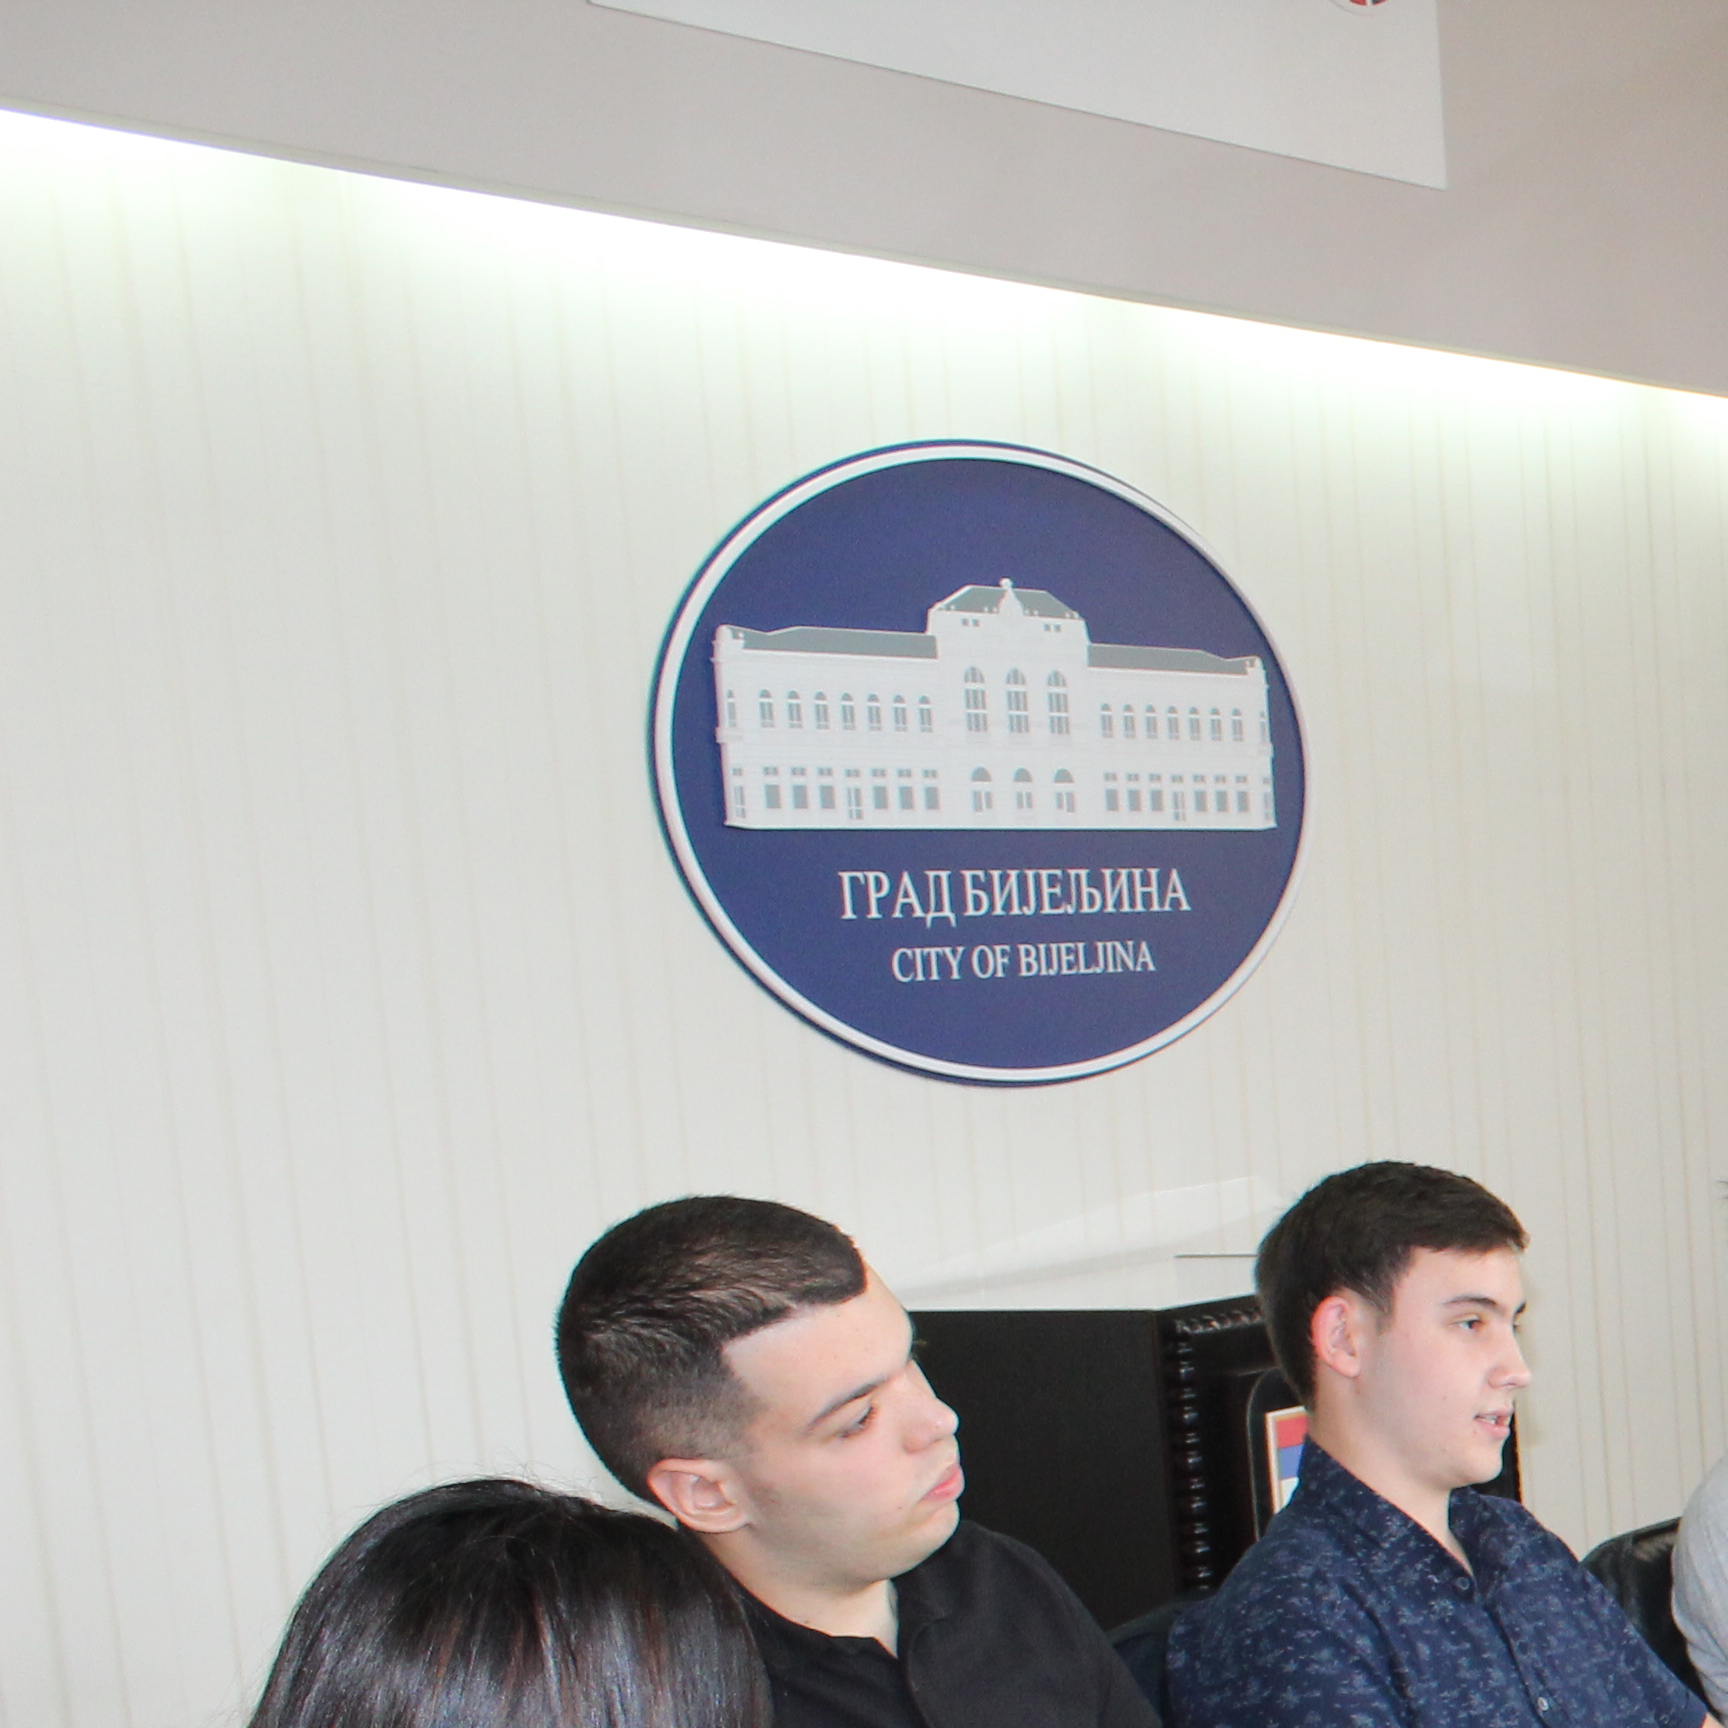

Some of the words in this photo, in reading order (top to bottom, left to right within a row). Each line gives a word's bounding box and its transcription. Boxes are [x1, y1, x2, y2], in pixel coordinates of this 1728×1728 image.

[837, 870, 958, 928] ГРАД
[960, 867, 1192, 917] БИЈЕЉИНА
[891, 946, 965, 983] CITY
[971, 944, 1011, 980] OF
[1017, 940, 1157, 977] BIJELJINA
